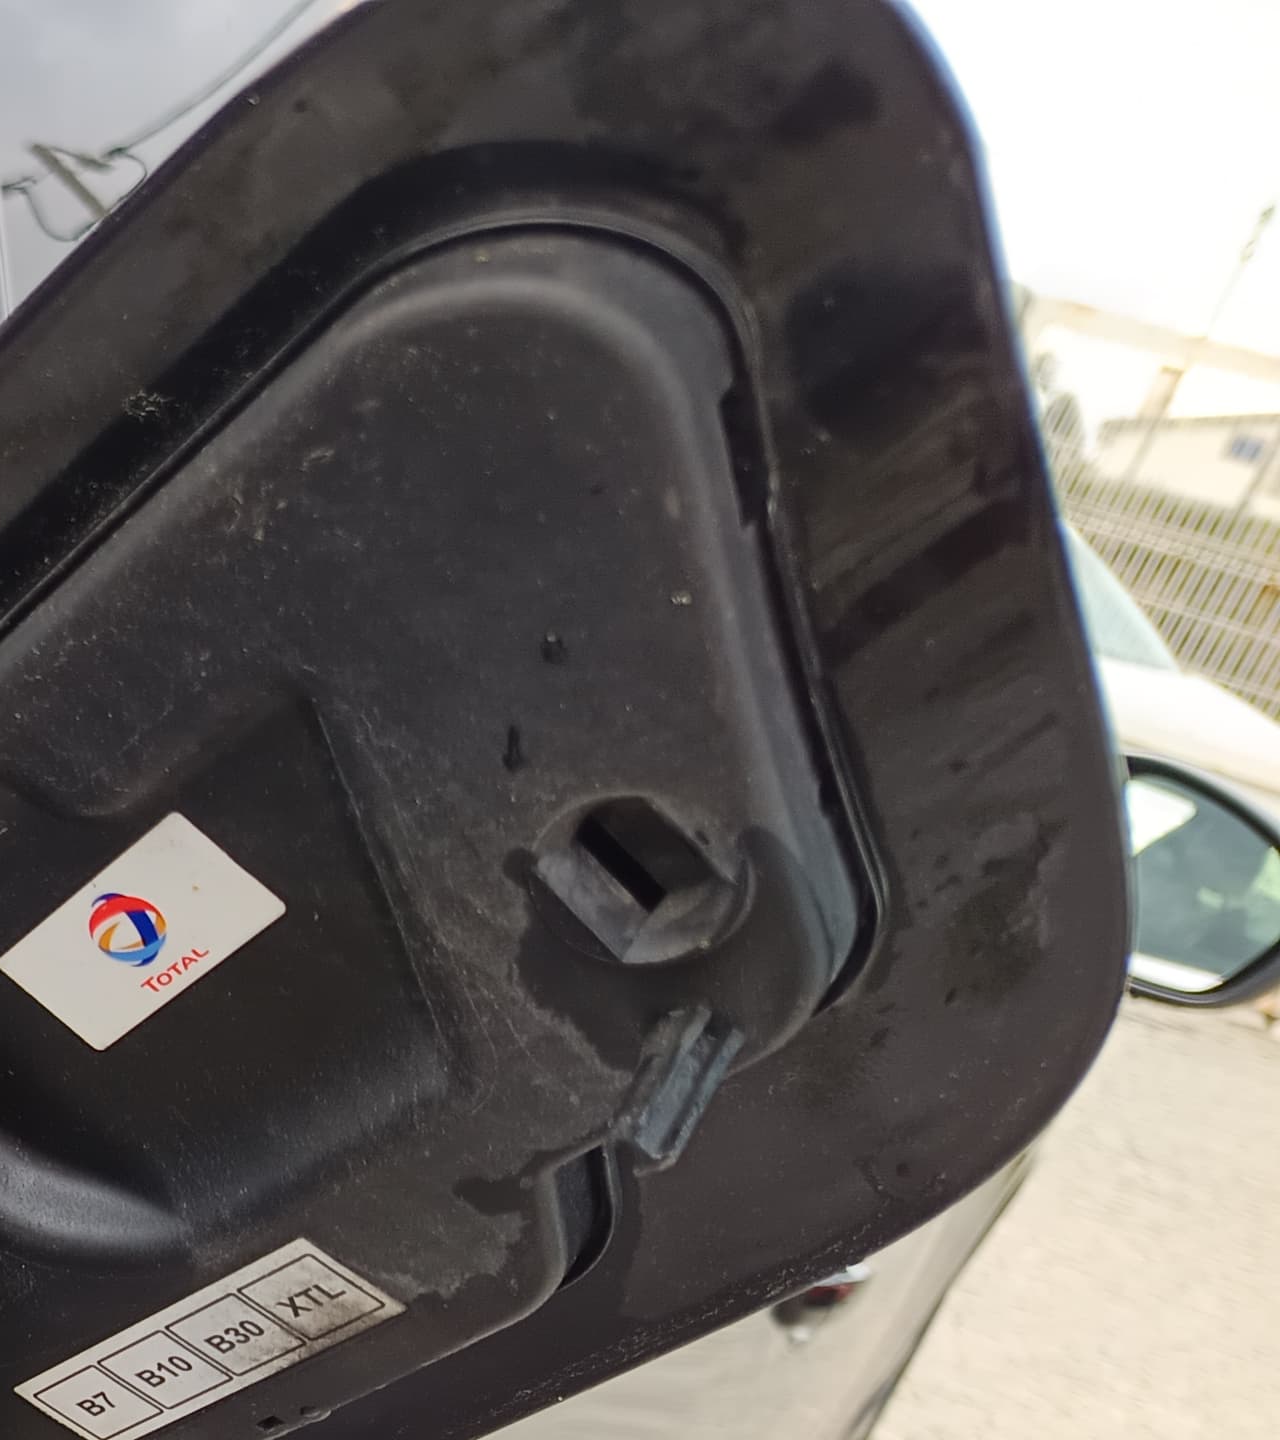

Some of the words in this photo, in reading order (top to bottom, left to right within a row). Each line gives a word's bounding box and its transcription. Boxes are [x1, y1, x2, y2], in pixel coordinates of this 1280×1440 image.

[140, 948, 209, 992] TOTAL
[75, 1391, 116, 1417] B7
[134, 1355, 193, 1388] B10
[203, 1319, 265, 1354] B30
[275, 1283, 347, 1318] XTL
